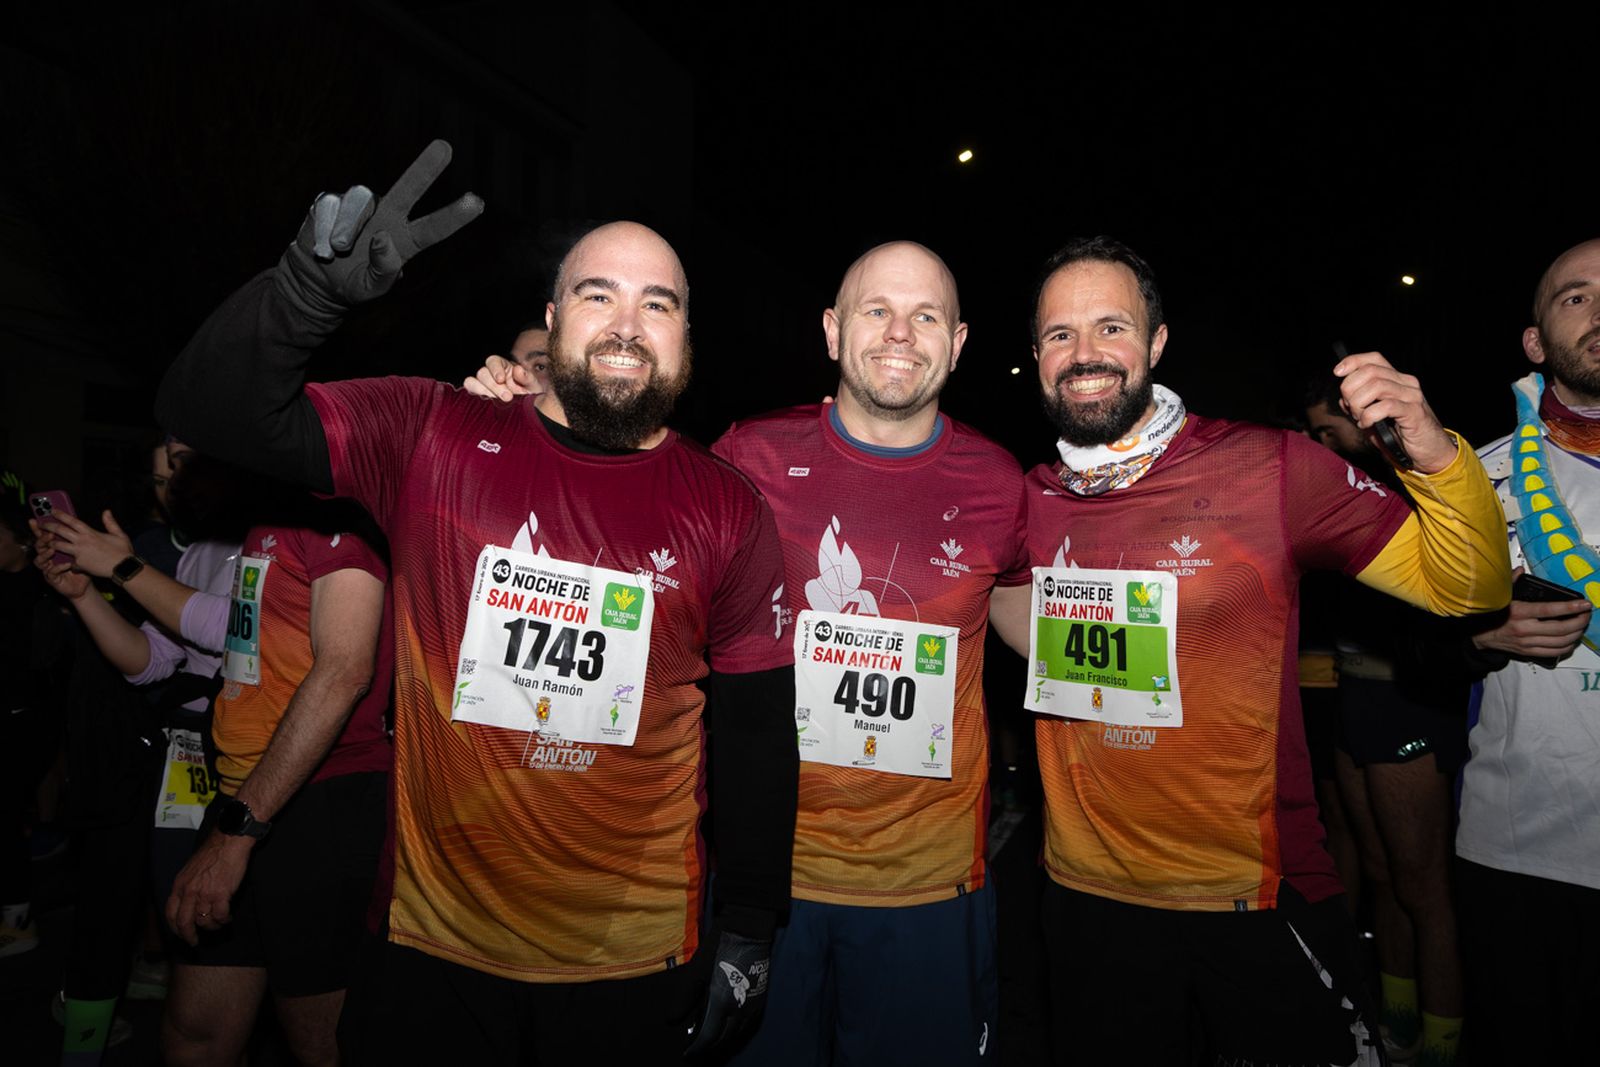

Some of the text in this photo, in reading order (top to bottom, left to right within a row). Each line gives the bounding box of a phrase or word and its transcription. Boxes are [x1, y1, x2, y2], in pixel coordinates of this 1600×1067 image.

[493, 564, 511, 579] 43
[929, 556, 972, 573] CAJA RURAL
[1155, 559, 1178, 568] CAJA
[1180, 558, 1214, 567] RURAL
[511, 572, 591, 602] NOCHE DE
[655, 573, 680, 590] RURAL
[1056, 585, 1096, 601] NOCHE
[1098, 587, 1113, 602] DE
[487, 588, 589, 625] SAN ANTÓN
[604, 608, 618, 617] CAJA
[1044, 601, 1114, 622] SAN ANTÓN
[815, 625, 830, 637] 43
[503, 617, 607, 682] 1743
[833, 630, 904, 652] NOCHE DE
[1064, 623, 1127, 672] 491
[812, 646, 902, 672] SAN ANTÓN
[513, 673, 584, 697] Juan Ramón
[1065, 669, 1128, 687] Juan Francisco
[833, 670, 916, 721] 490
[853, 719, 891, 734] Manuel
[1104, 726, 1157, 744] ANTÓN
[530, 744, 598, 766] ANTÓN
